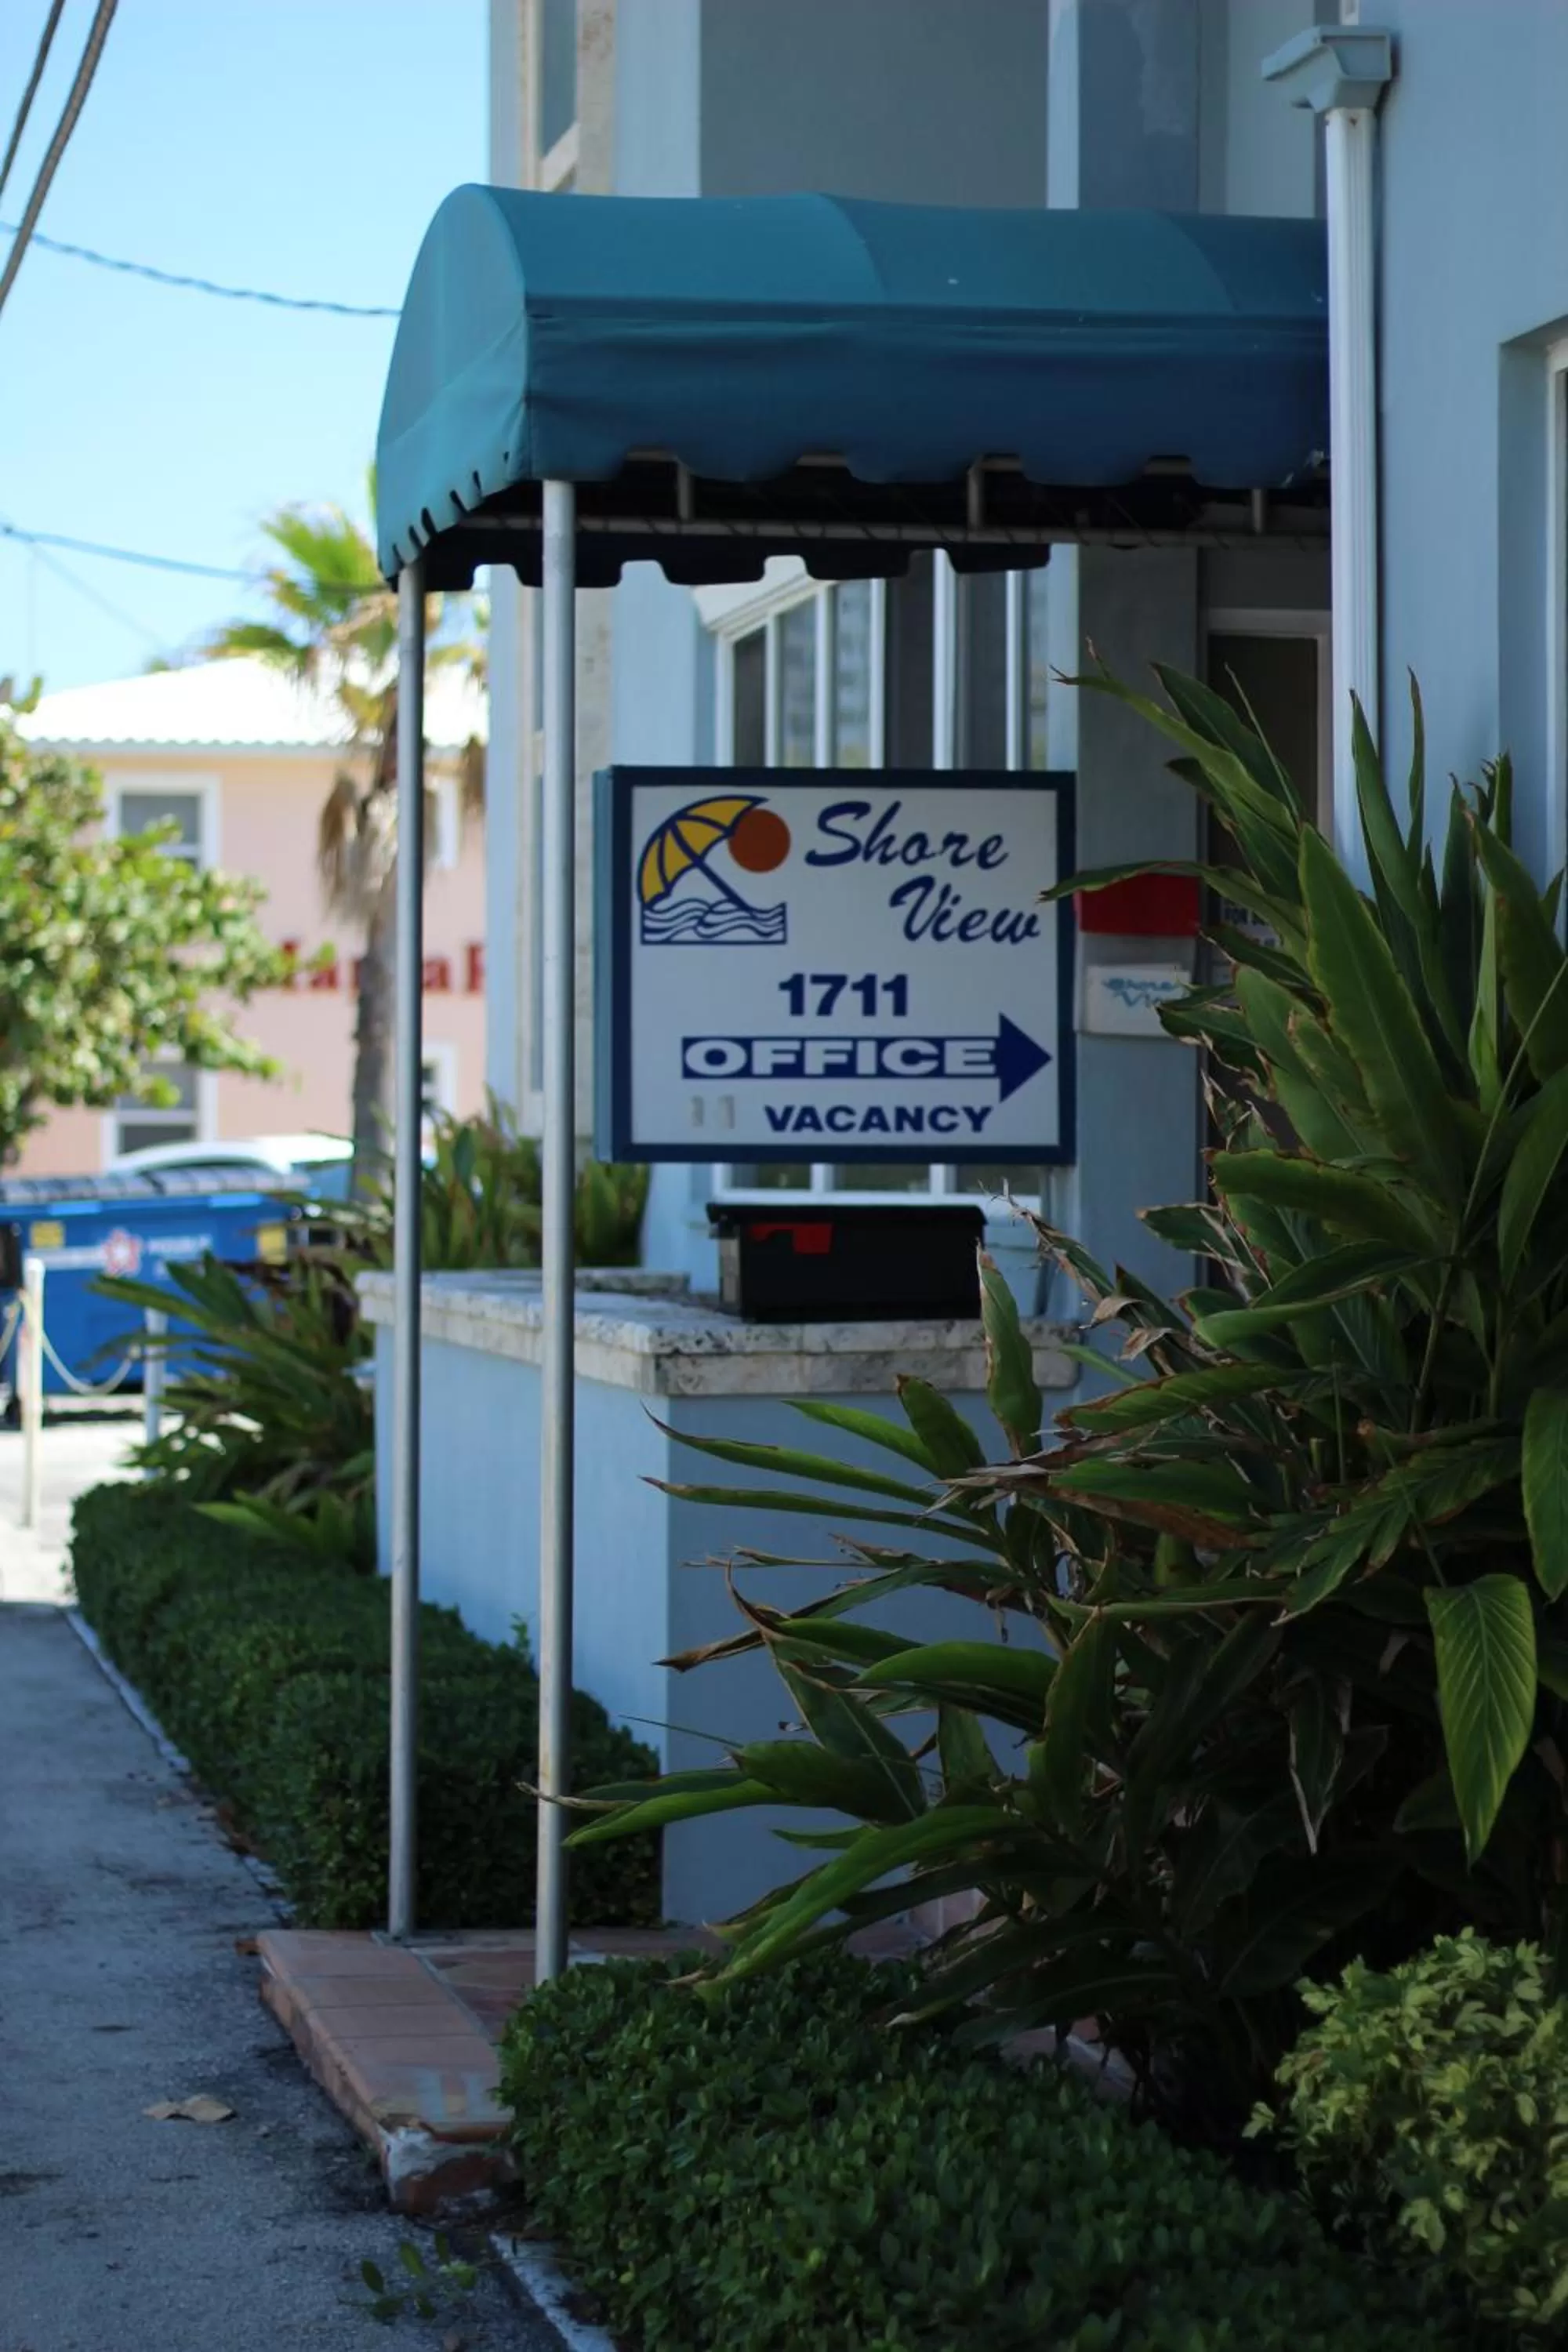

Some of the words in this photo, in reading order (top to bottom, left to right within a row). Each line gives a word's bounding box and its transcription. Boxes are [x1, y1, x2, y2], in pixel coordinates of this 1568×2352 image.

[804, 800, 1009, 870] Shore
[888, 875, 1041, 945] View
[779, 973, 909, 1017] 1711
[684, 1039, 996, 1076] OFFICE
[764, 1105, 993, 1133] VACANCY
